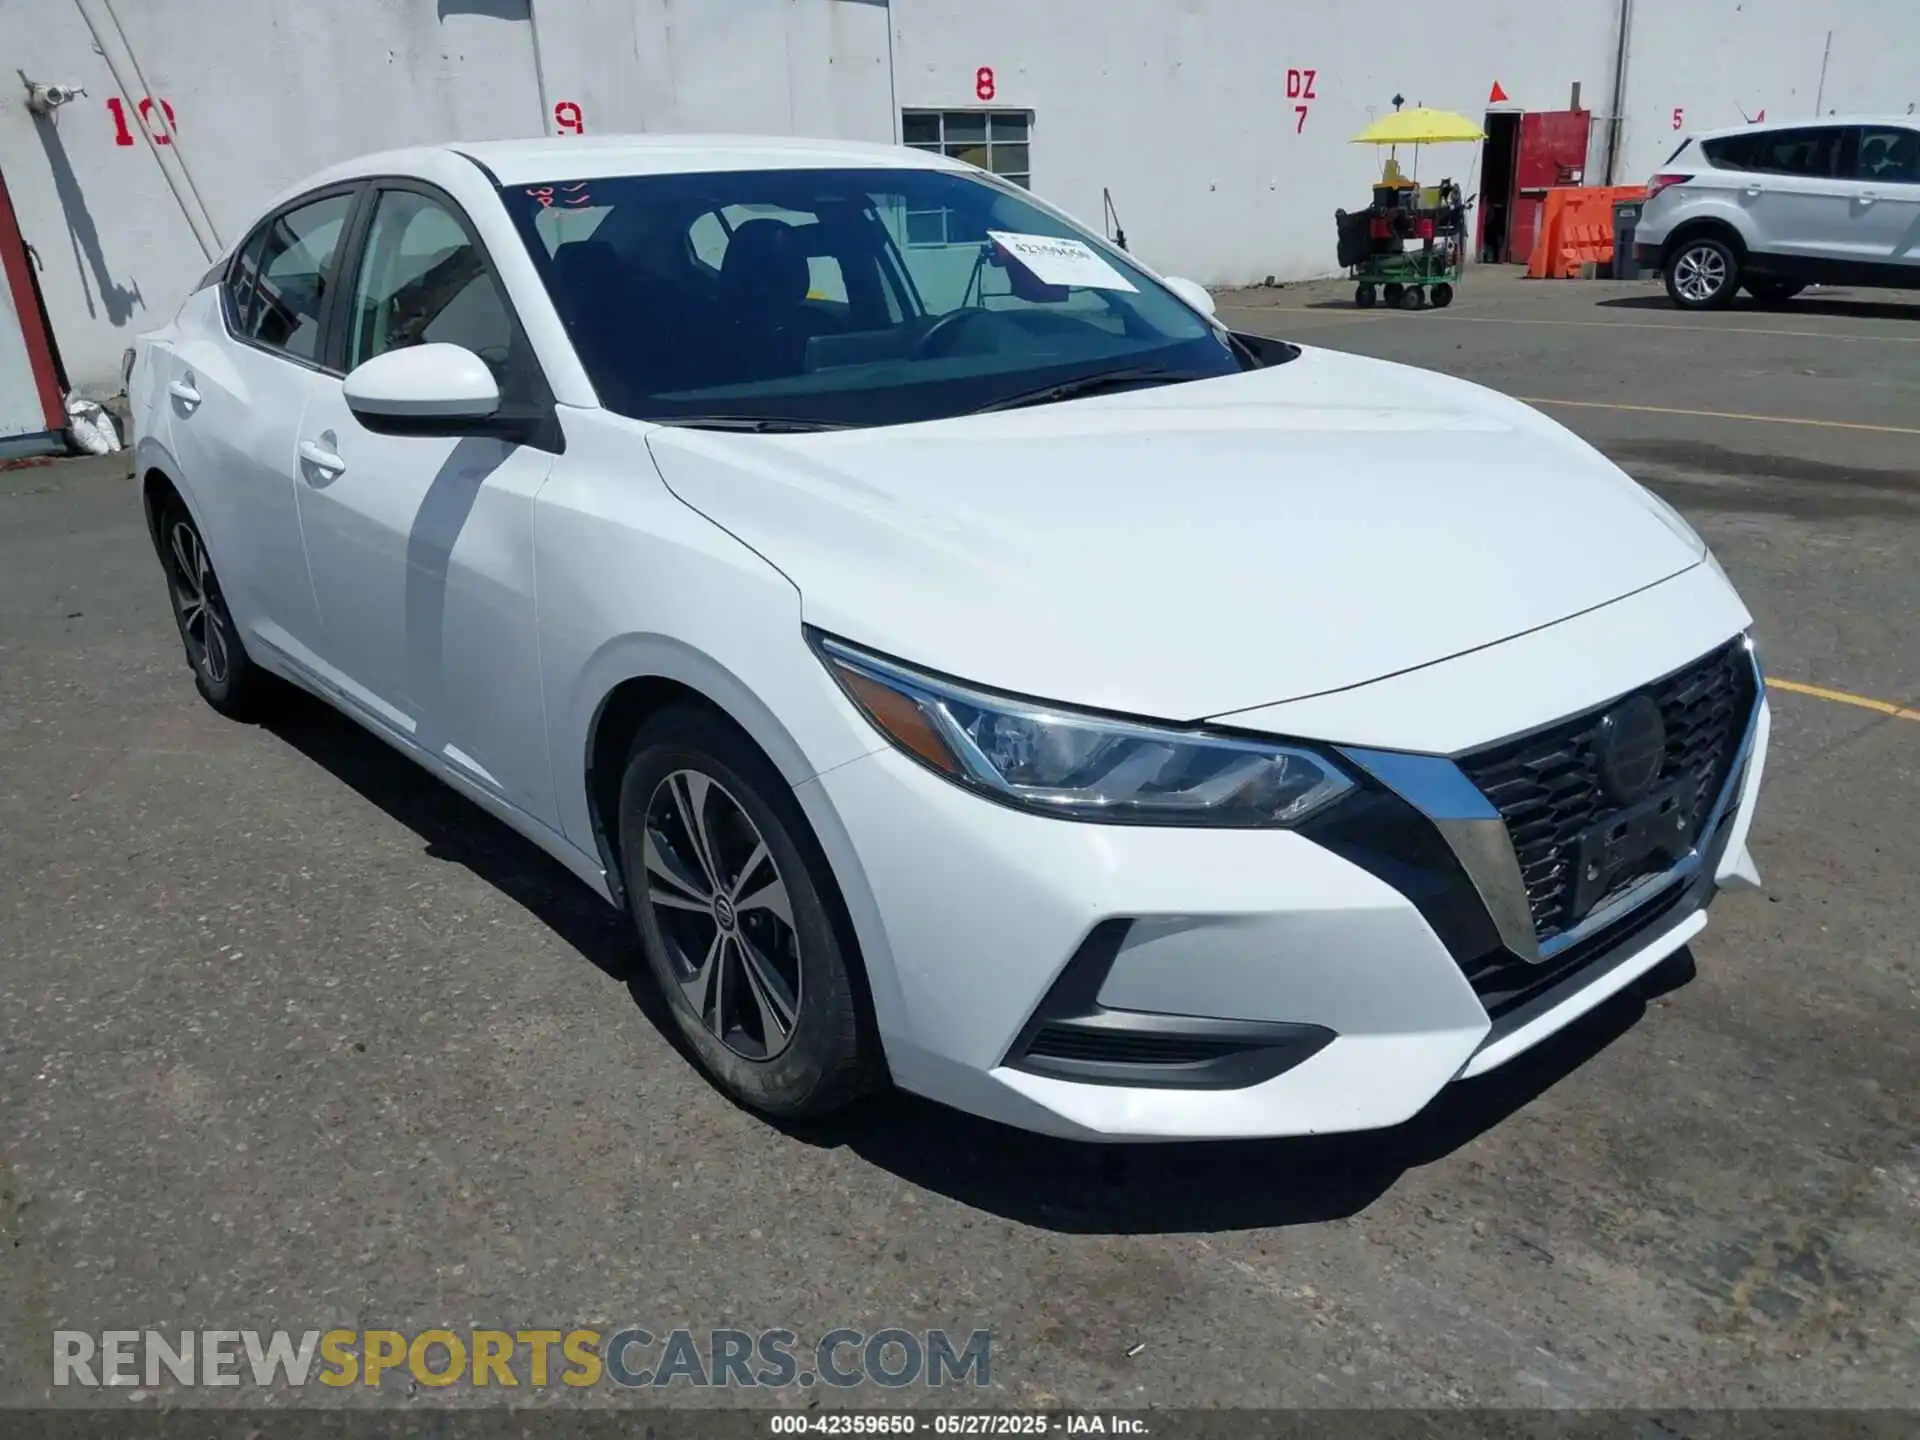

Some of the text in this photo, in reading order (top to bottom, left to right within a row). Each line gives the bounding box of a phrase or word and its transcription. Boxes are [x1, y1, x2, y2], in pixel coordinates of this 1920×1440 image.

[976, 67, 995, 101] 8
[1287, 69, 1316, 99] DZ
[106, 97, 177, 146] 10
[555, 101, 584, 135] 9
[1295, 105, 1308, 134] 7
[1673, 108, 1683, 130] 5
